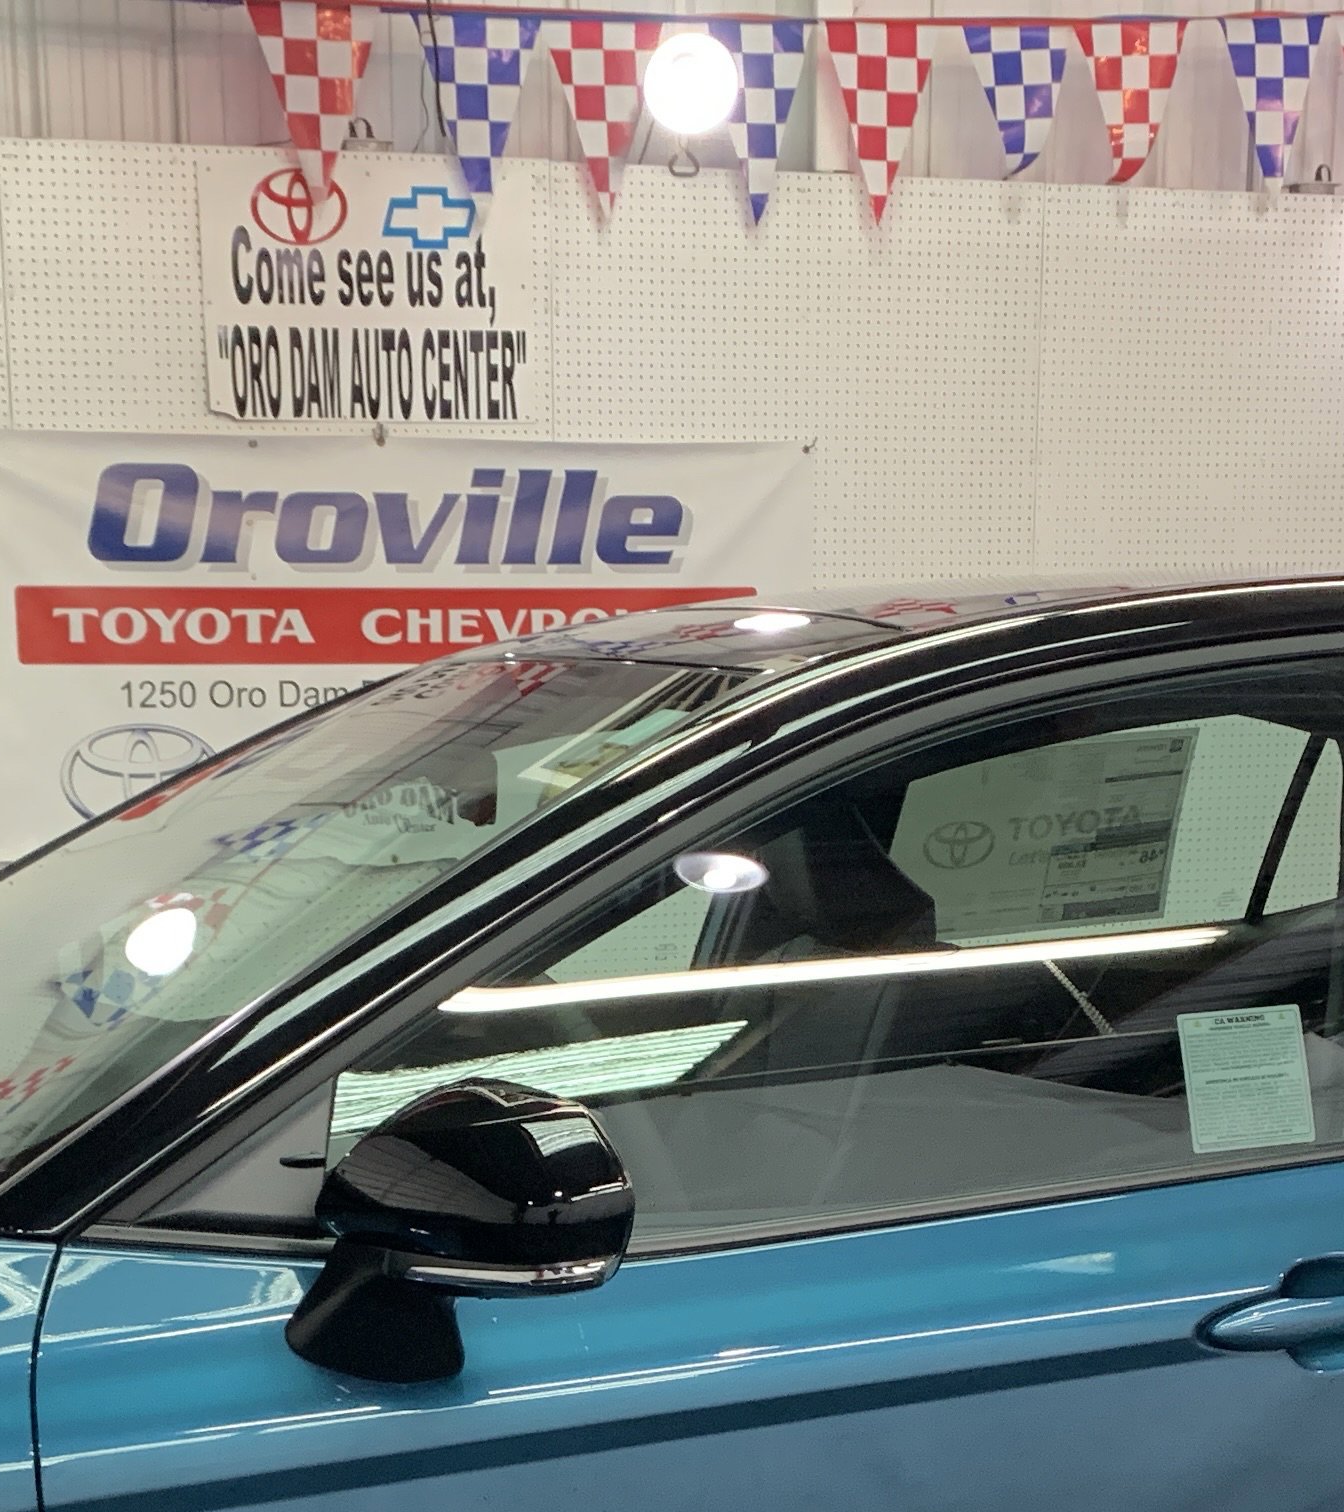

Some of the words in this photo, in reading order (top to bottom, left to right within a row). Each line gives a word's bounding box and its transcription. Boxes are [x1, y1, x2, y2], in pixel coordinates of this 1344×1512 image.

[231, 225, 326, 305] Come
[337, 248, 394, 307] see
[406, 249, 444, 308] us
[455, 234, 496, 326] at,
[217, 323, 282, 419] "ORO
[288, 326, 343, 419] DAM
[350, 327, 414, 420] AUTO
[421, 327, 527, 420] CENTER"
[86, 462, 689, 570] Oroville
[53, 607, 316, 645] TOYOTA
[120, 680, 198, 708] 1250
[209, 680, 267, 708] Oro
[279, 680, 349, 708] Dam
